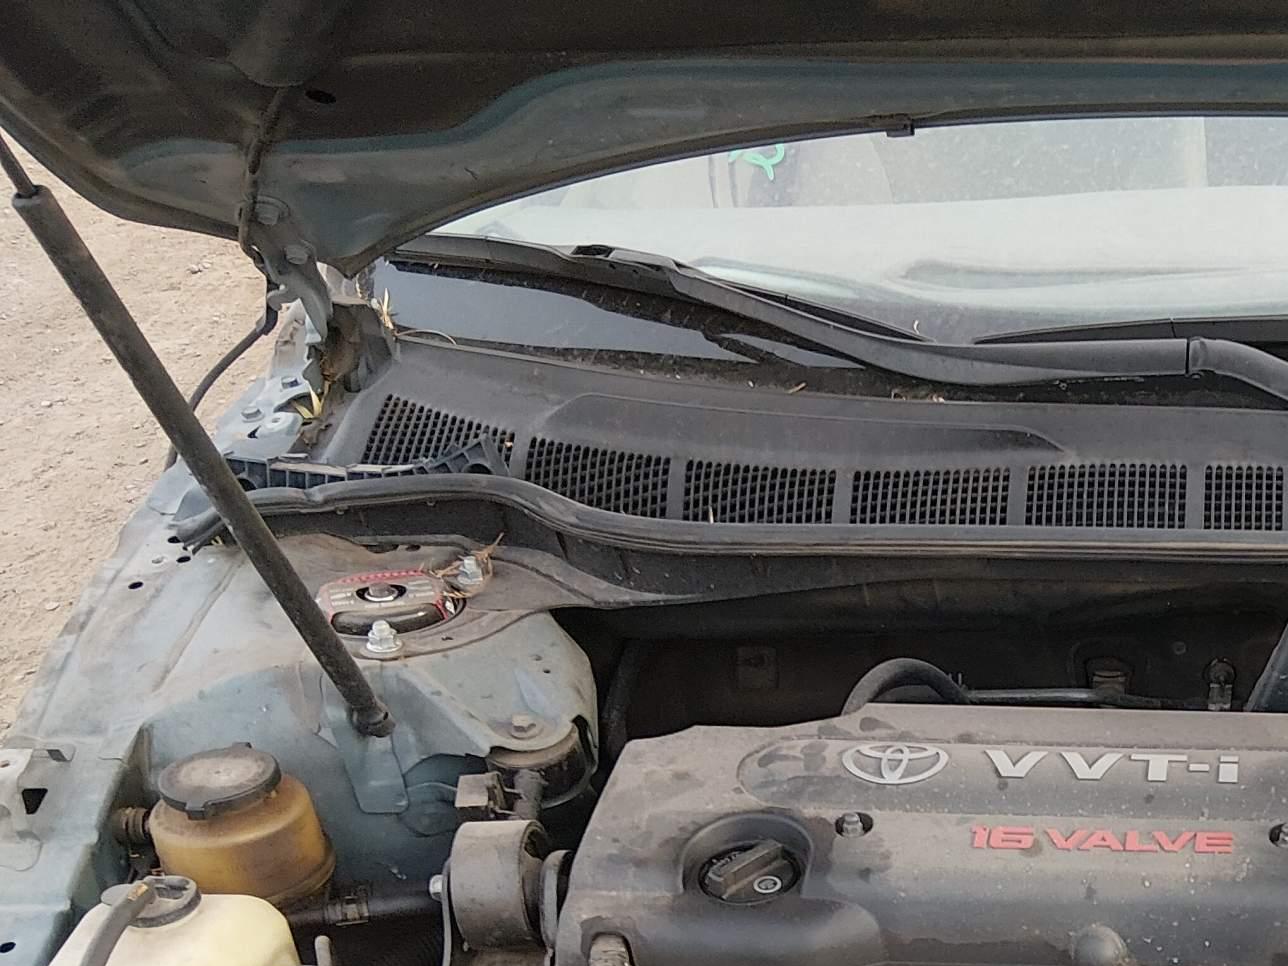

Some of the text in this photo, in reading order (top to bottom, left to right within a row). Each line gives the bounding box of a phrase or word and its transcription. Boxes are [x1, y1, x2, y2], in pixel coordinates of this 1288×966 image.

[985, 749, 1239, 783] VVT-i
[970, 825, 1235, 854] 16 VALVE
